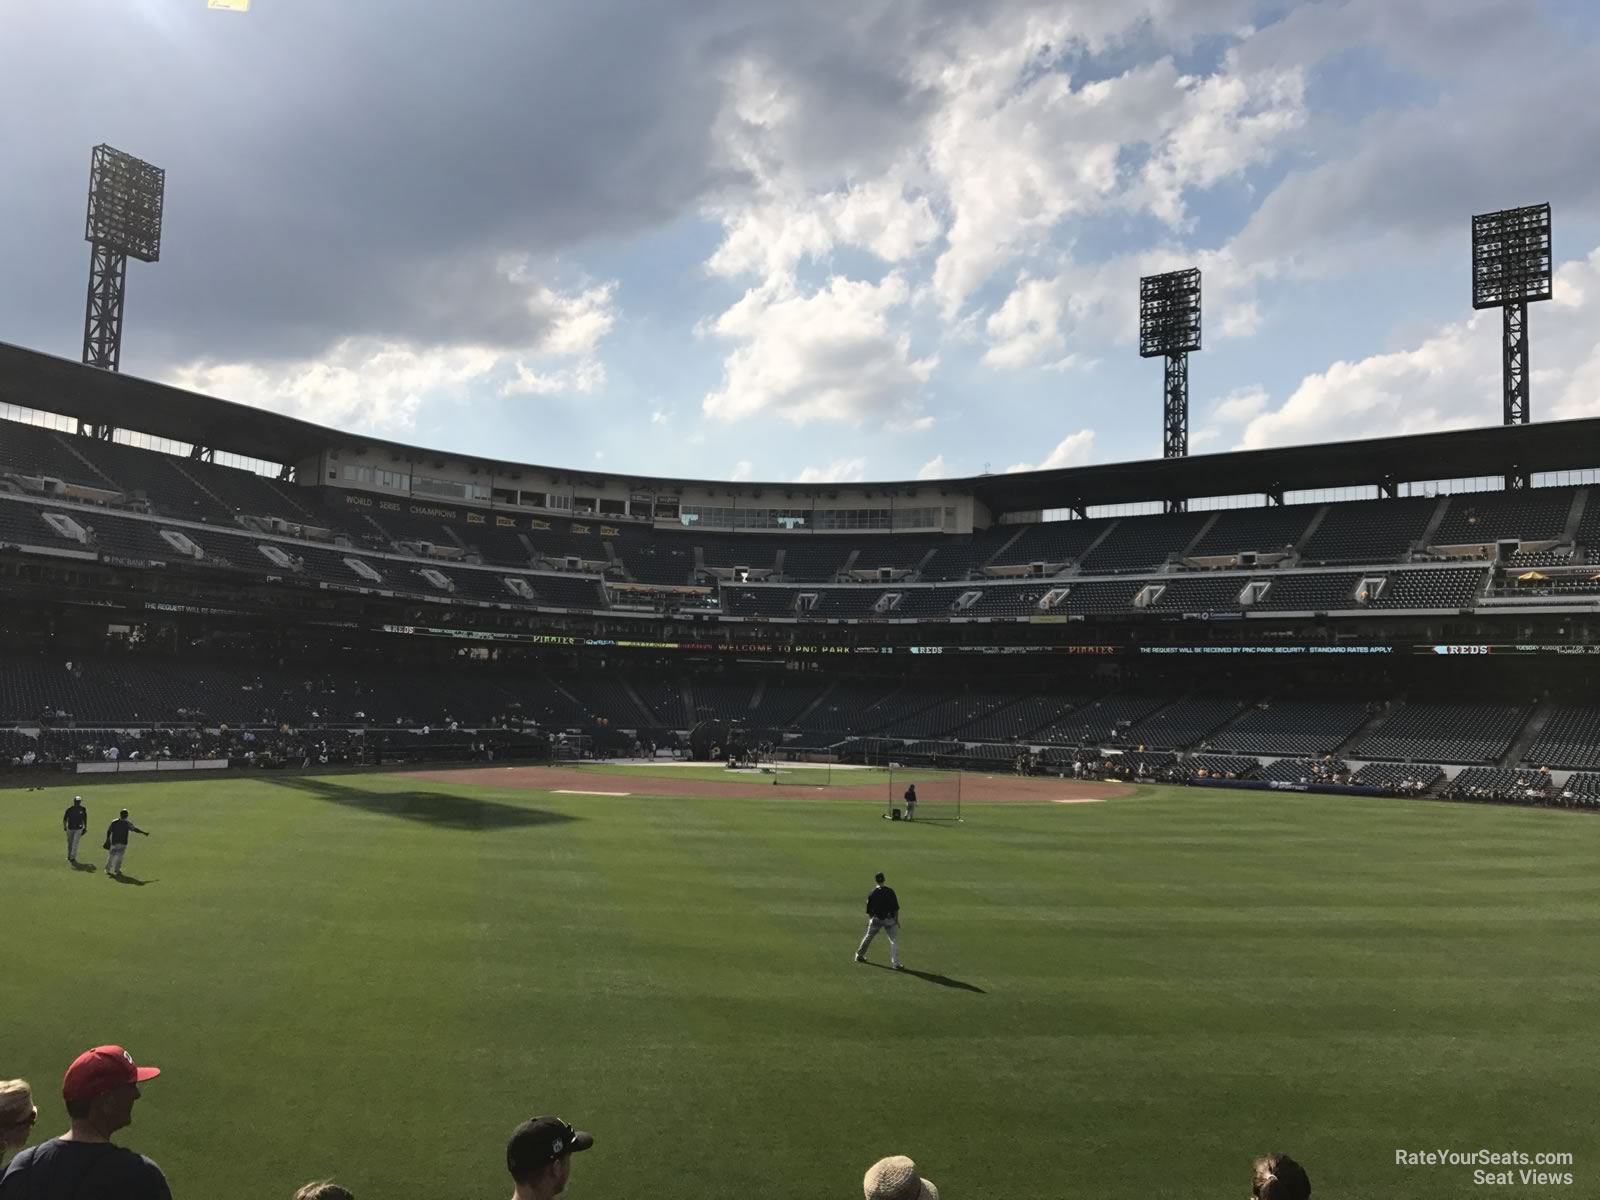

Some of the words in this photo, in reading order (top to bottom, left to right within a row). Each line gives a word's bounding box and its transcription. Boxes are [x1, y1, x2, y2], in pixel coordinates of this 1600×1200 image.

[346, 495, 372, 506] WORLD
[410, 506, 456, 519] CHAMPIONS
[718, 644, 773, 652] WELCOME
[778, 645, 791, 653] TO
[919, 646, 943, 654] REDS
[1450, 645, 1488, 654] REDS
